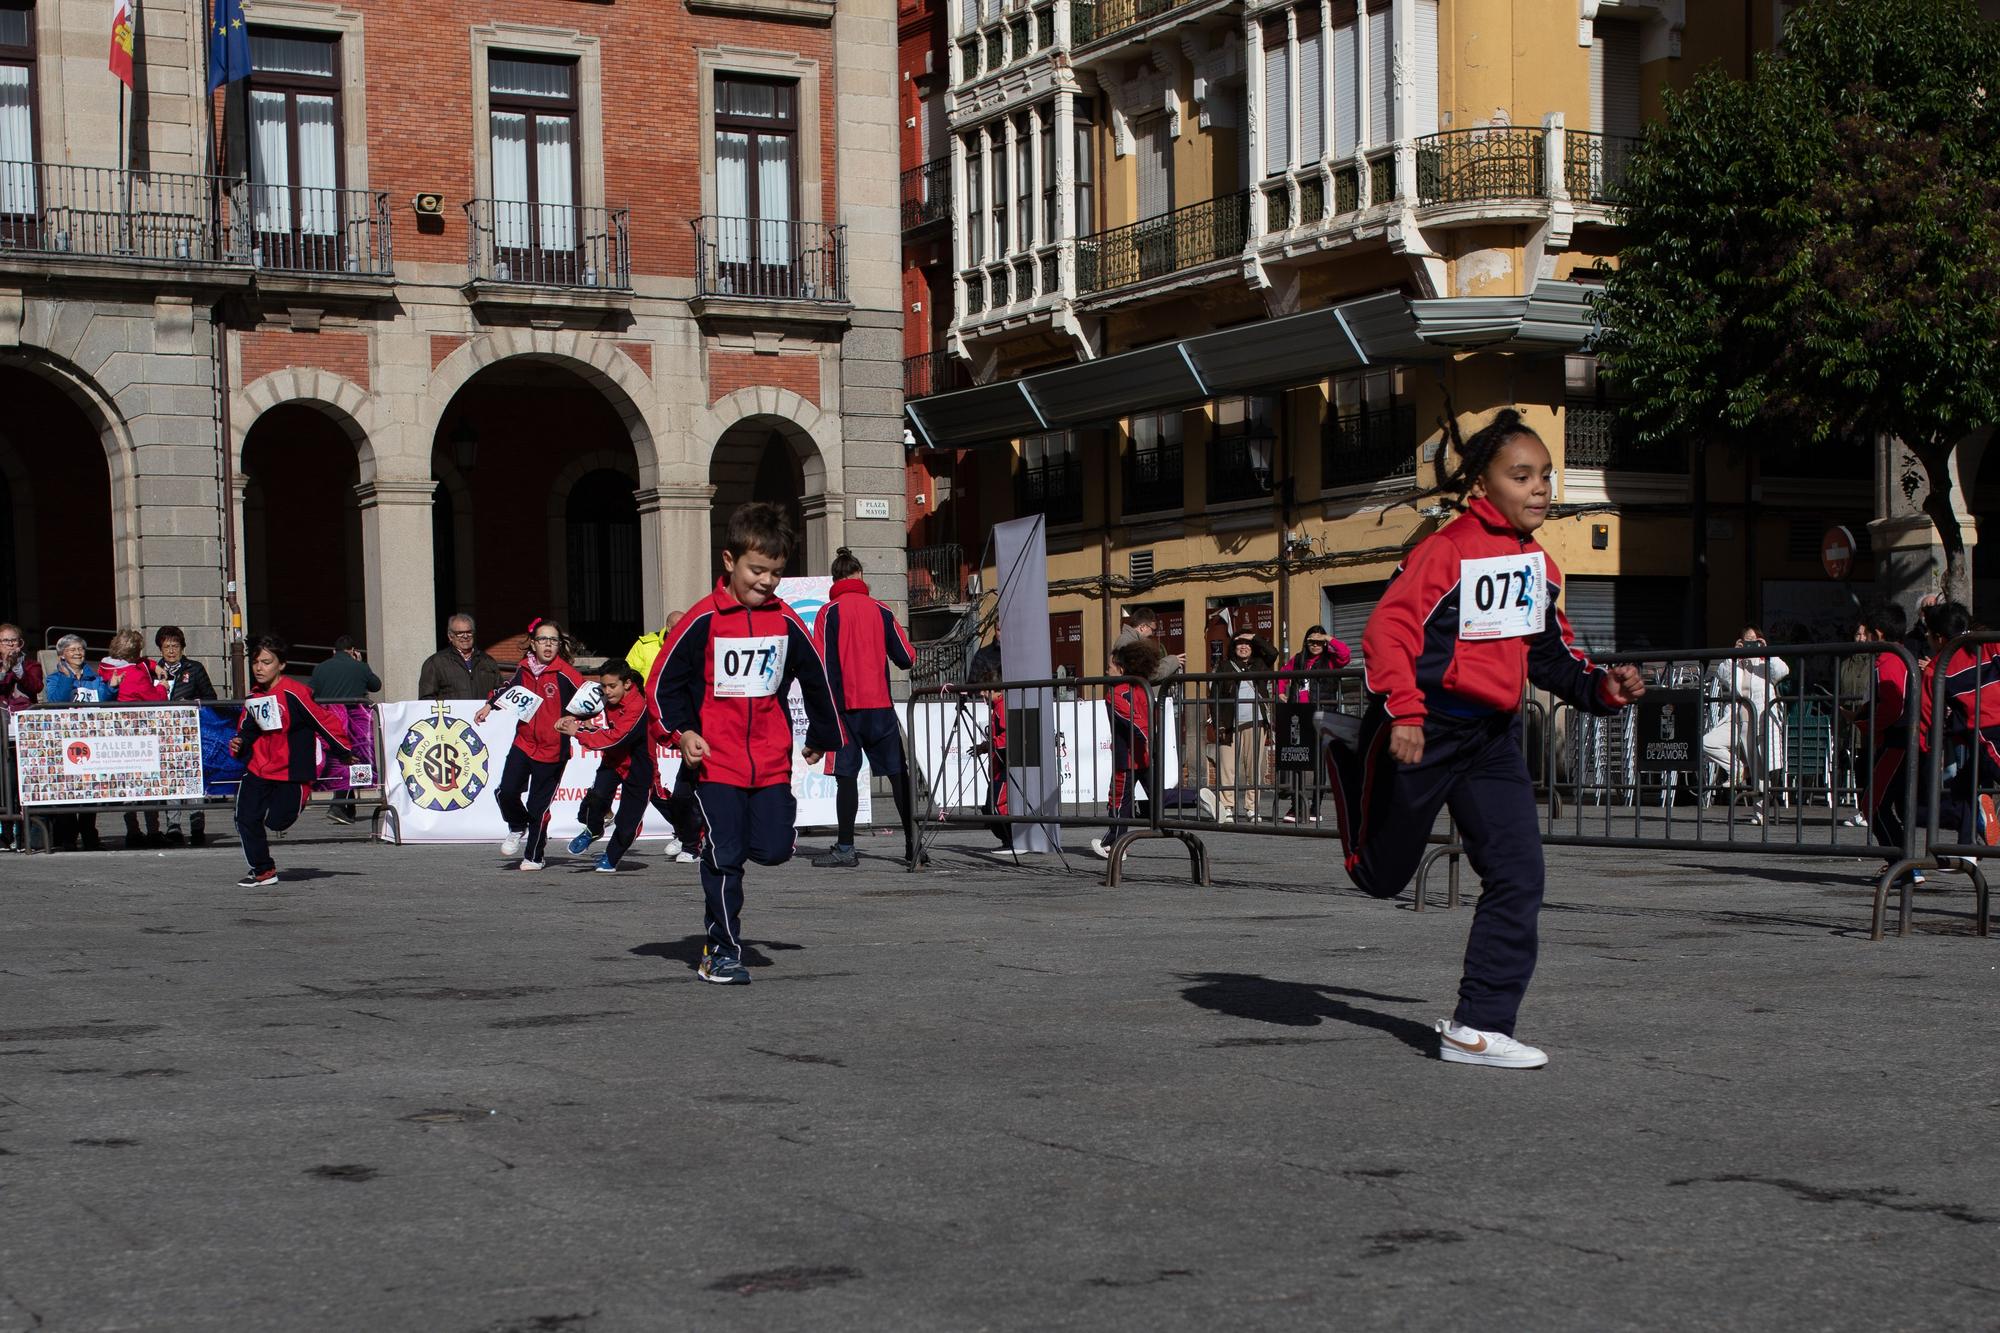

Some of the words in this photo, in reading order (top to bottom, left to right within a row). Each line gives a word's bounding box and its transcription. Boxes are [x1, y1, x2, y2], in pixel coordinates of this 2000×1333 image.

[1475, 571, 1528, 611] 072
[1258, 620, 1272, 629] LOBO
[724, 650, 771, 677] 077
[505, 689, 529, 708] 069
[95, 741, 133, 750] TALLER
[140, 740, 153, 749] DE
[1647, 742, 1689, 750] AYUNTAMIENTO
[69, 746, 88, 756] TDS
[96, 750, 153, 759] SOLIDARIDAD
[415, 740, 430, 778] TRABAJO
[435, 734, 445, 742] FE
[462, 752, 471, 777] AMOR
[1647, 750, 1656, 760] DE
[1657, 750, 1689, 760] ZAMORA
[1288, 753, 1310, 762] ZAMORA
